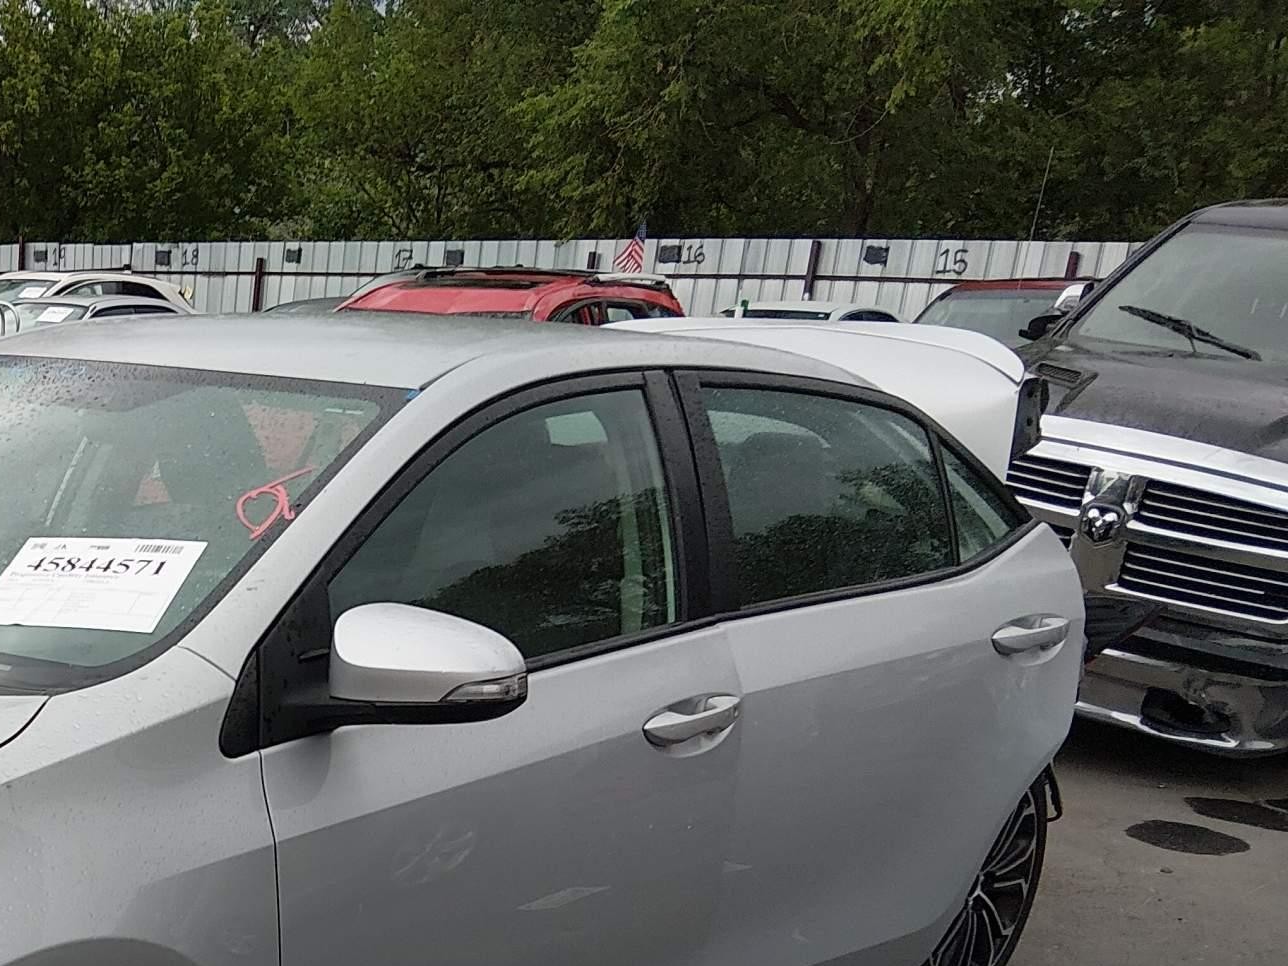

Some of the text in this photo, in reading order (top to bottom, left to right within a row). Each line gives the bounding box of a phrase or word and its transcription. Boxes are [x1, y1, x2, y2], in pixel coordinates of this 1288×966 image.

[182, 247, 199, 266] 18
[393, 249, 413, 270] 17
[682, 244, 705, 265] 16
[935, 248, 969, 275] 15
[27, 555, 168, 576] 45844571
